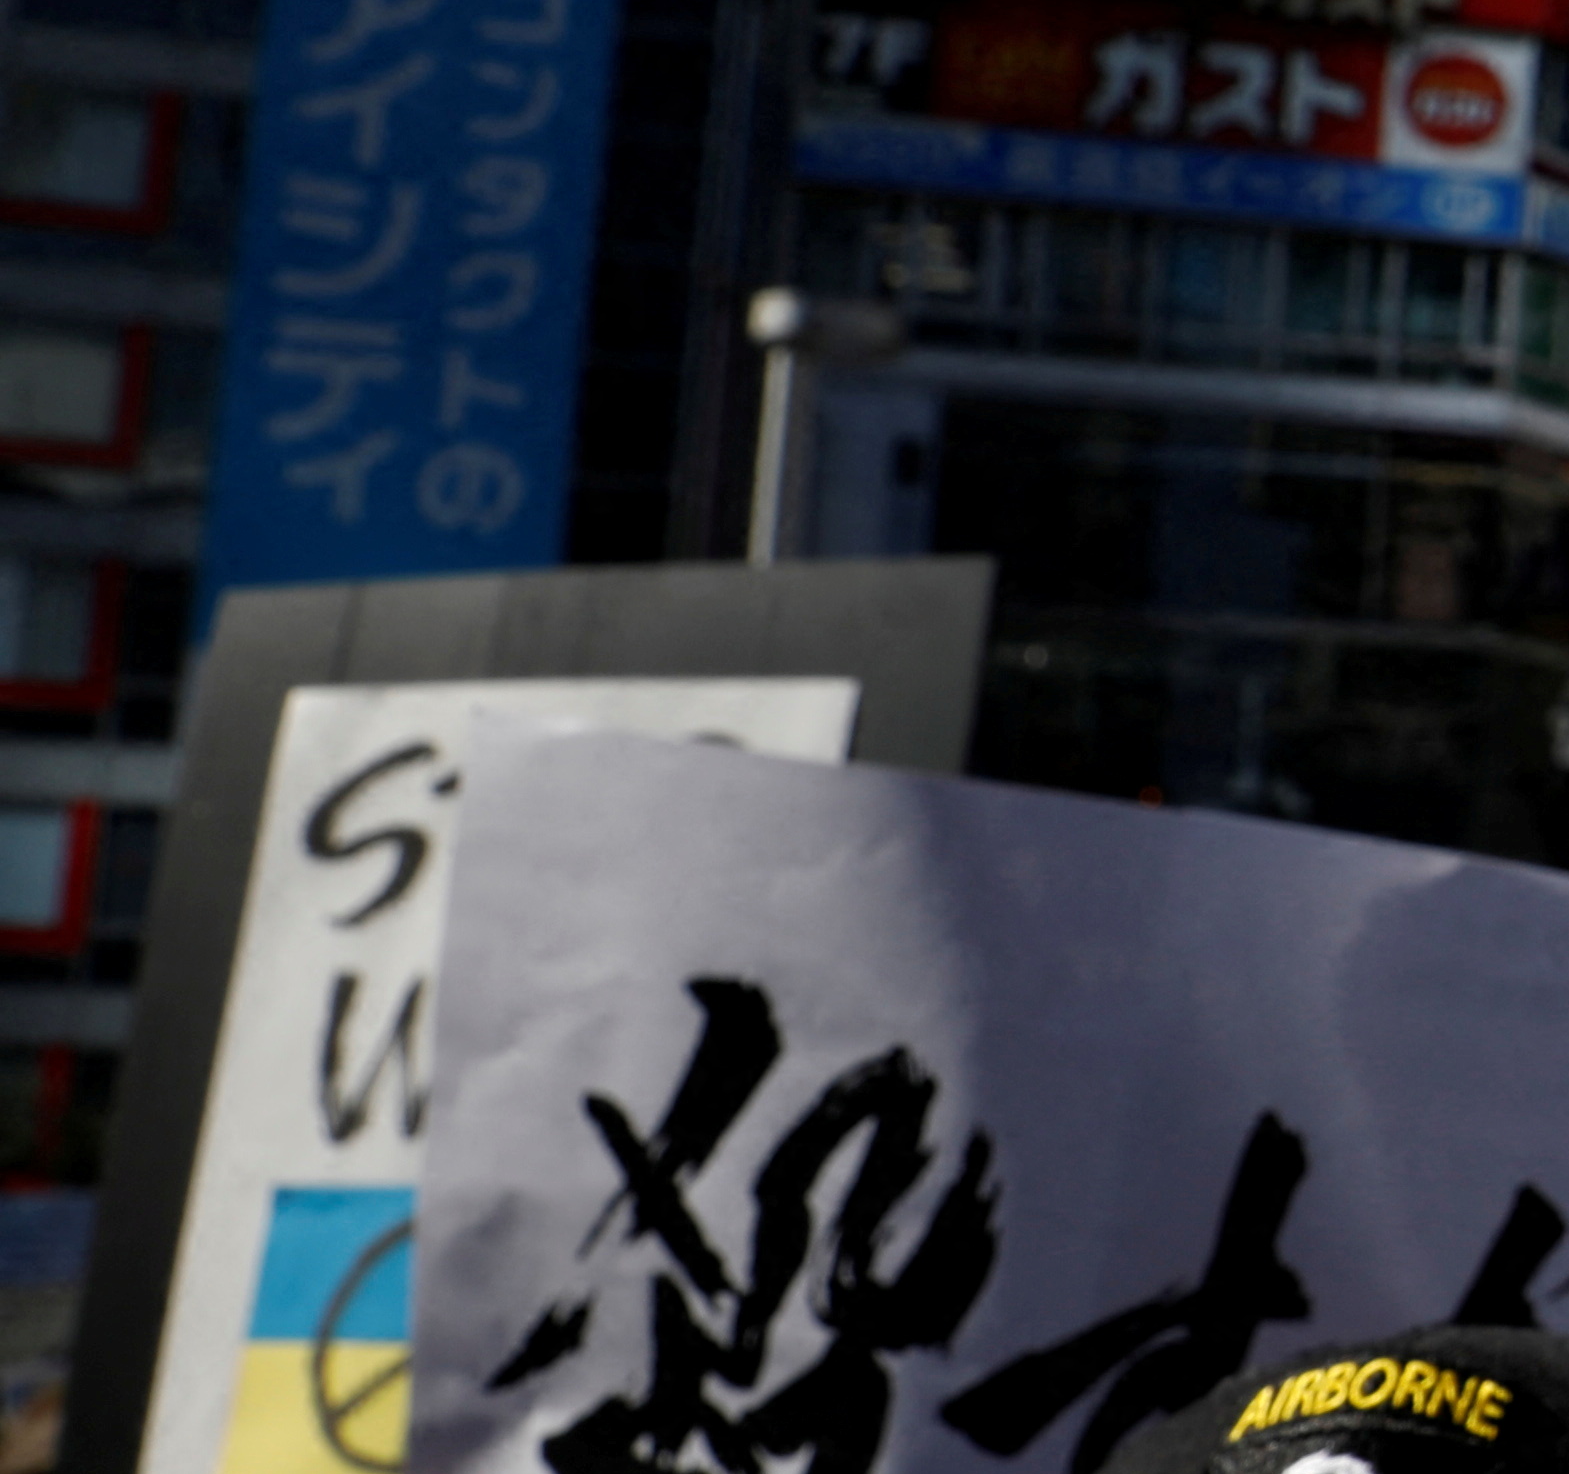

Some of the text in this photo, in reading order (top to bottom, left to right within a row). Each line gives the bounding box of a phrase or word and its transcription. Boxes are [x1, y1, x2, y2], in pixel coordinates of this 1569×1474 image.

[1086, 32, 1366, 147] ガスト
[1227, 1357, 1514, 1443] AIRBORNE
